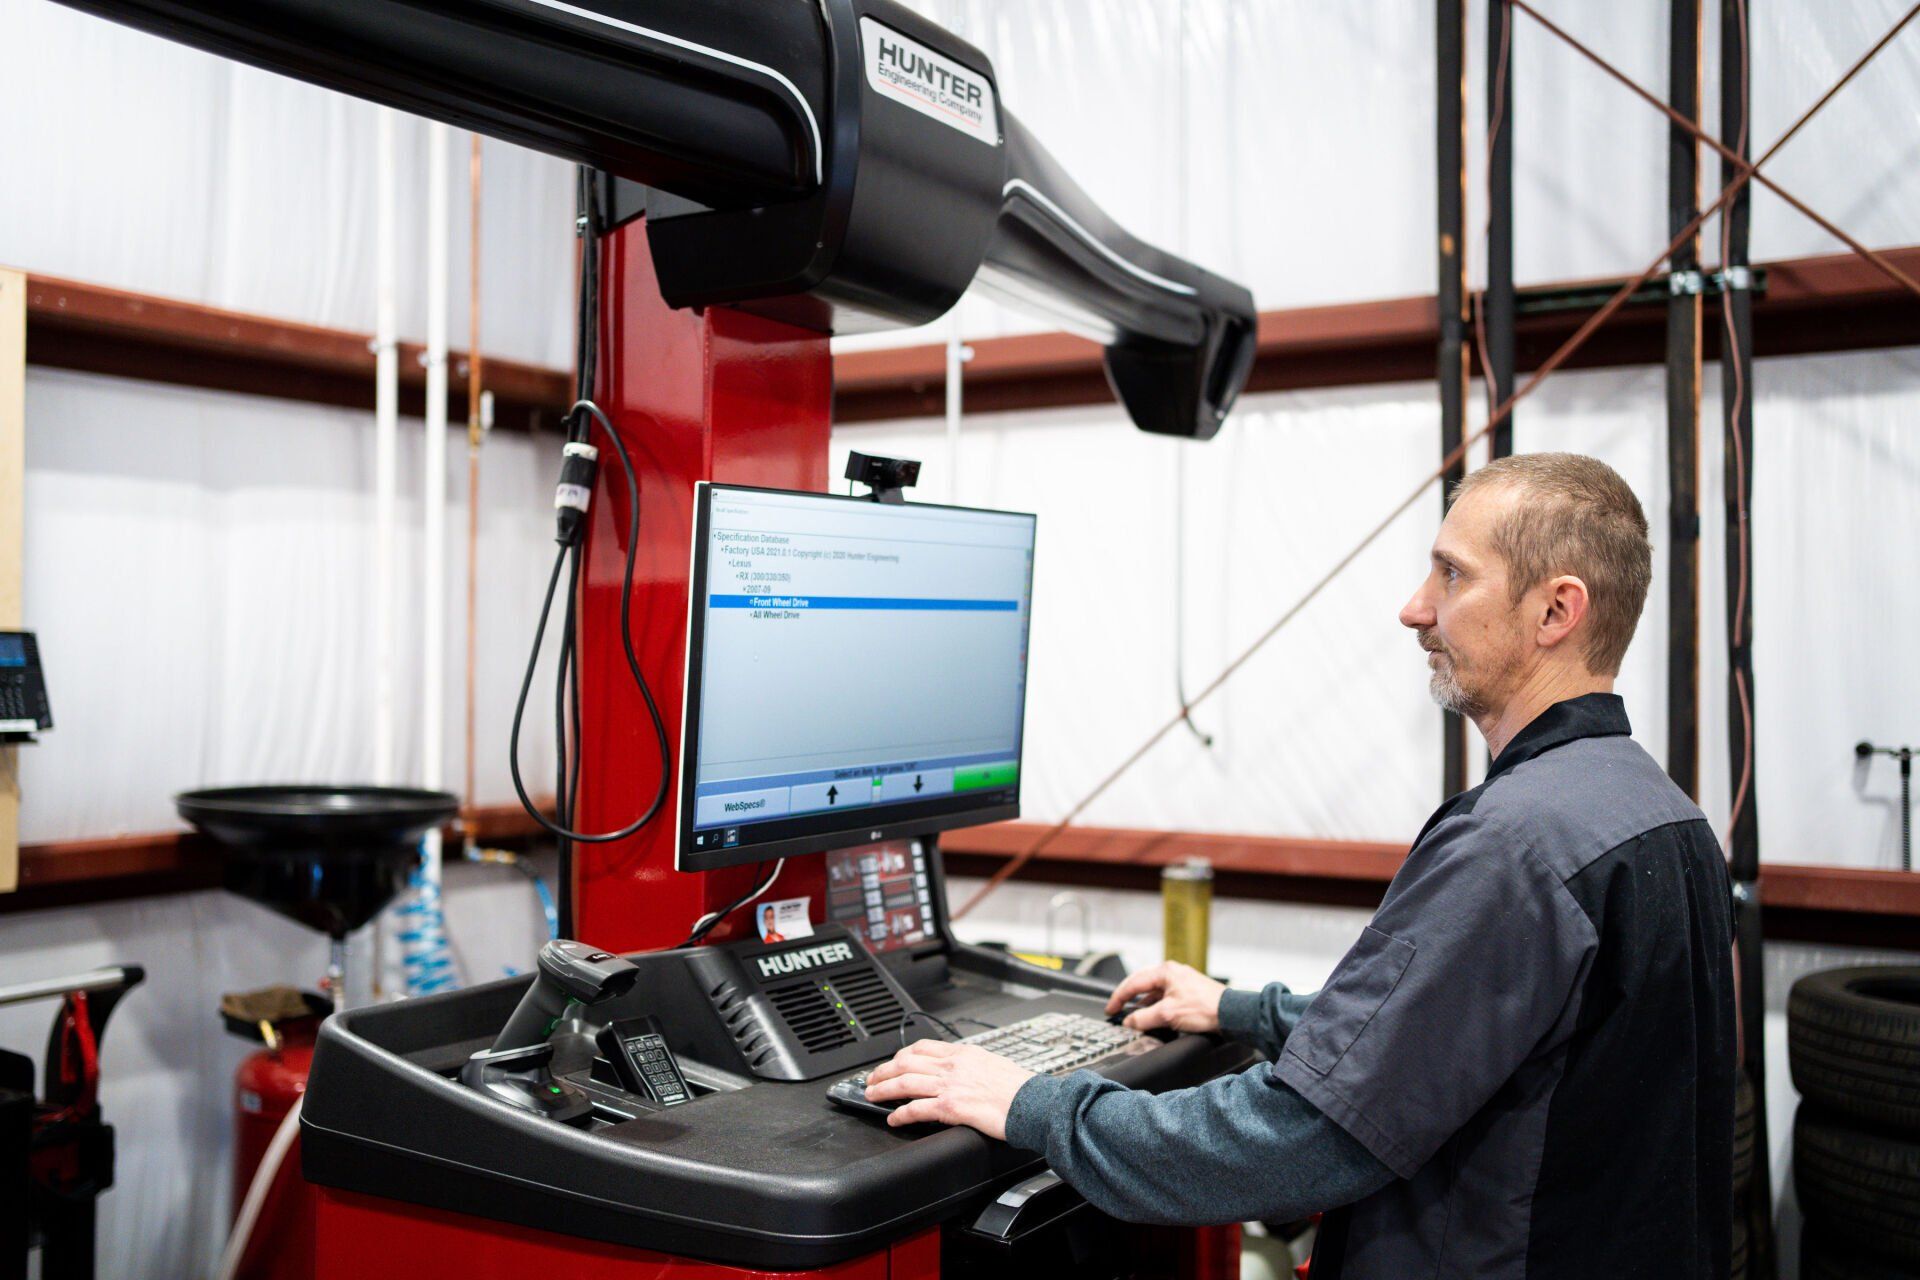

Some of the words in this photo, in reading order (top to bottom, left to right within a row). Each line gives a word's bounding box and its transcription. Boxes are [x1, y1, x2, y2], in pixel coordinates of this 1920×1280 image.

[879, 36, 982, 108] HUNTER
[878, 62, 937, 102] Engineering
[938, 91, 983, 123] Company
[717, 532, 759, 543] Specification
[761, 534, 789, 544] Database
[724, 545, 749, 556] Factory
[751, 547, 765, 555] USA
[793, 549, 822, 560] Copyright
[732, 559, 751, 568] Lexus
[739, 572, 749, 580] RX
[754, 597, 770, 606] Front
[772, 598, 791, 607] Wheel
[792, 598, 809, 607] Drive
[753, 610, 763, 619] All
[763, 611, 783, 619] Wheel
[783, 611, 800, 620] Drive
[757, 942, 853, 977] HUNTER
